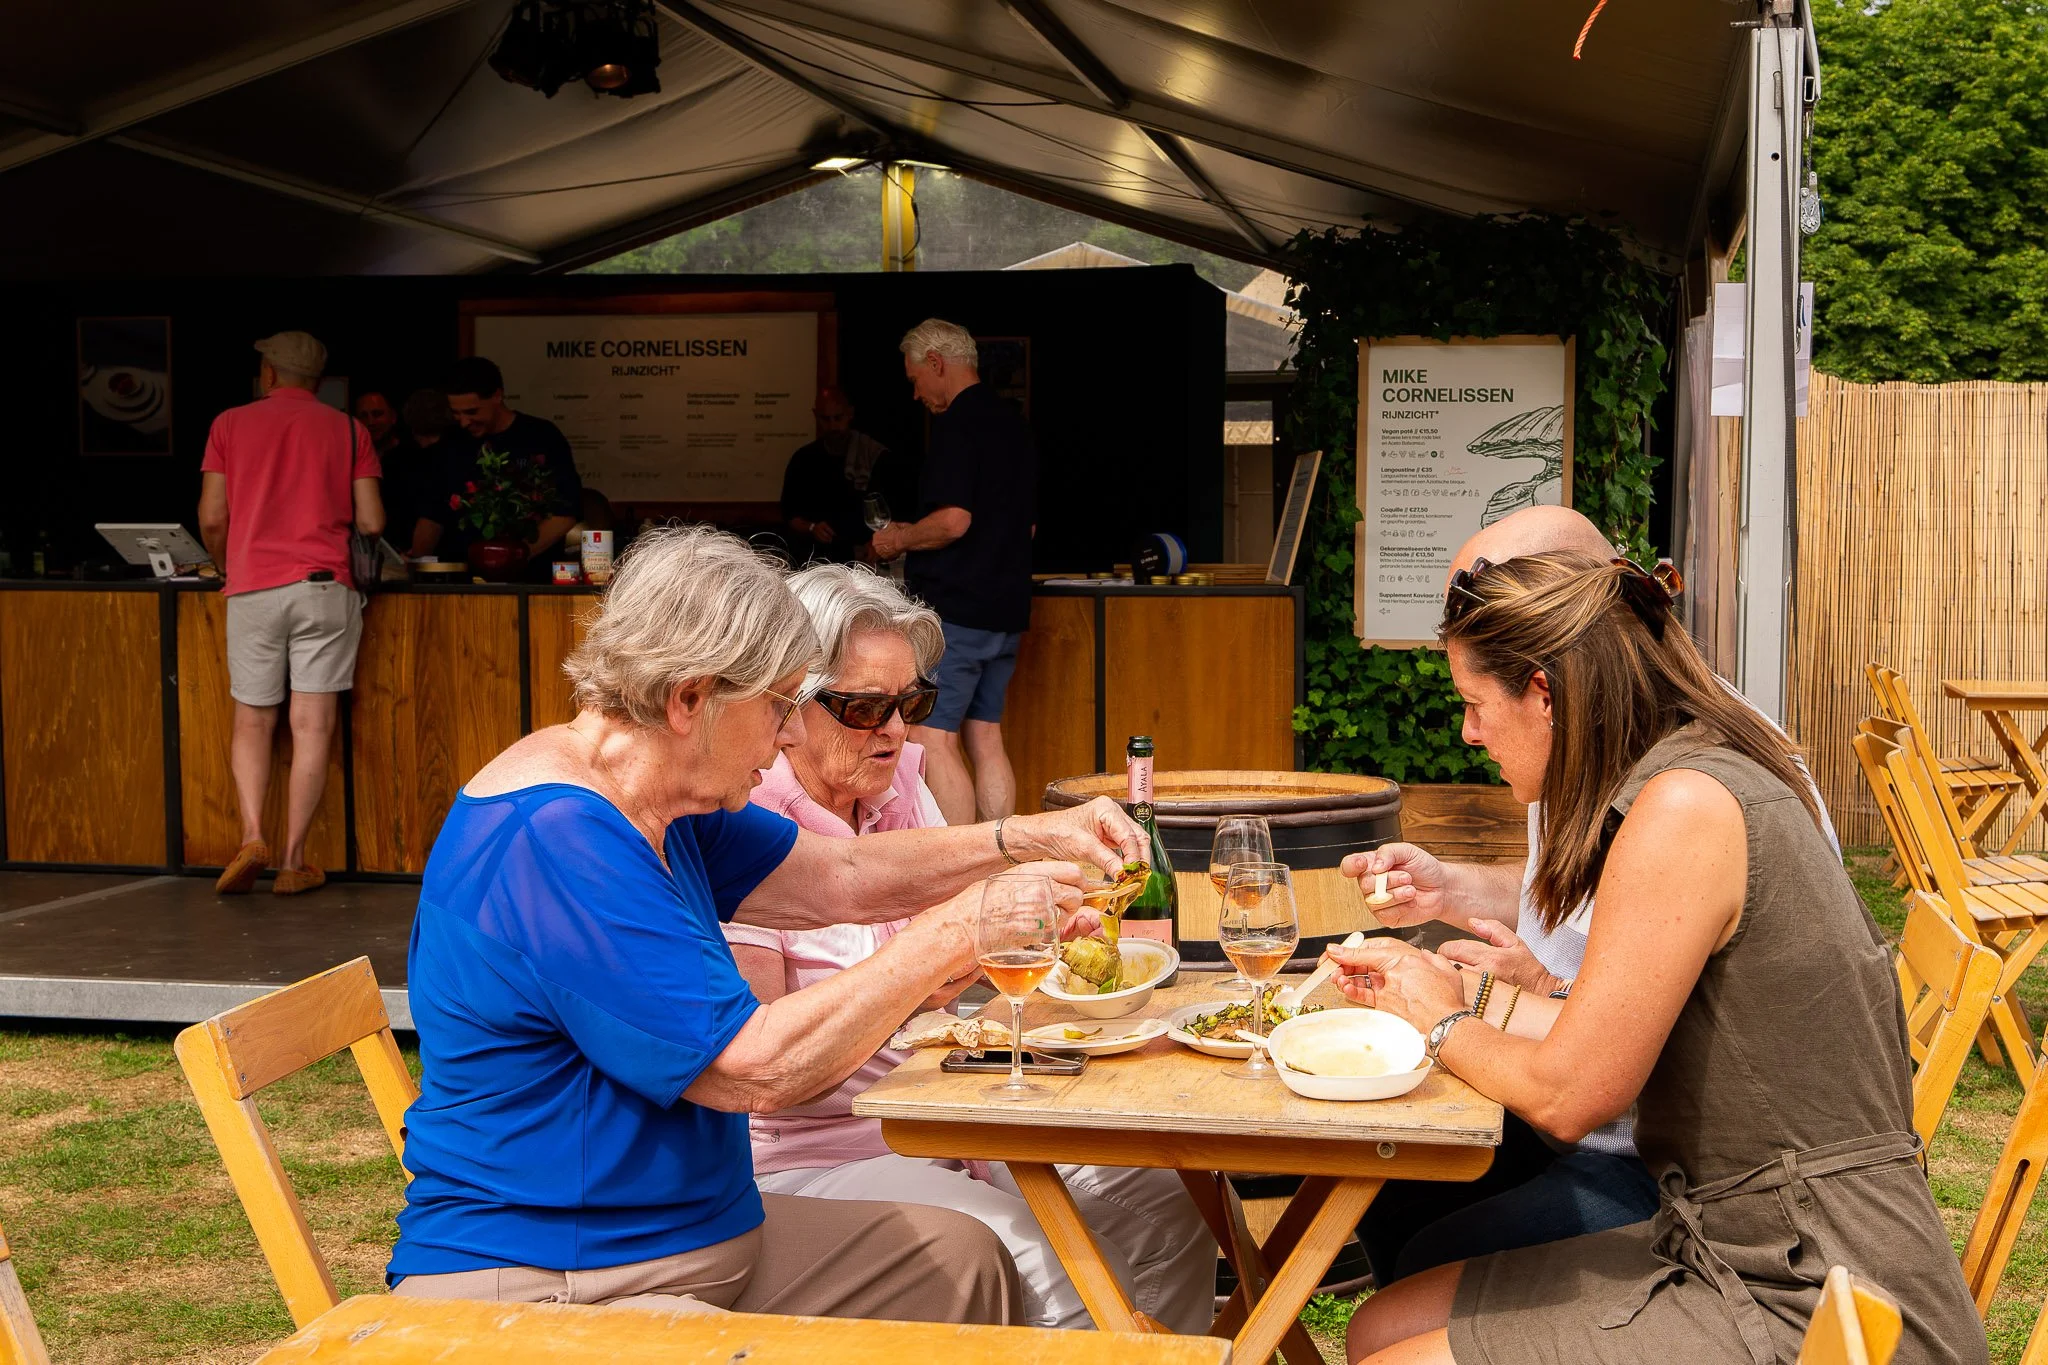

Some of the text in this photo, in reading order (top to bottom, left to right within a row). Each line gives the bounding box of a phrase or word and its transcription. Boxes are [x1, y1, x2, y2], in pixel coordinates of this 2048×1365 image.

[546, 340, 748, 358] MIKE CORNELISSEN
[1382, 370, 1428, 384] MIKE
[1382, 388, 1514, 402] CORNELISSEN
